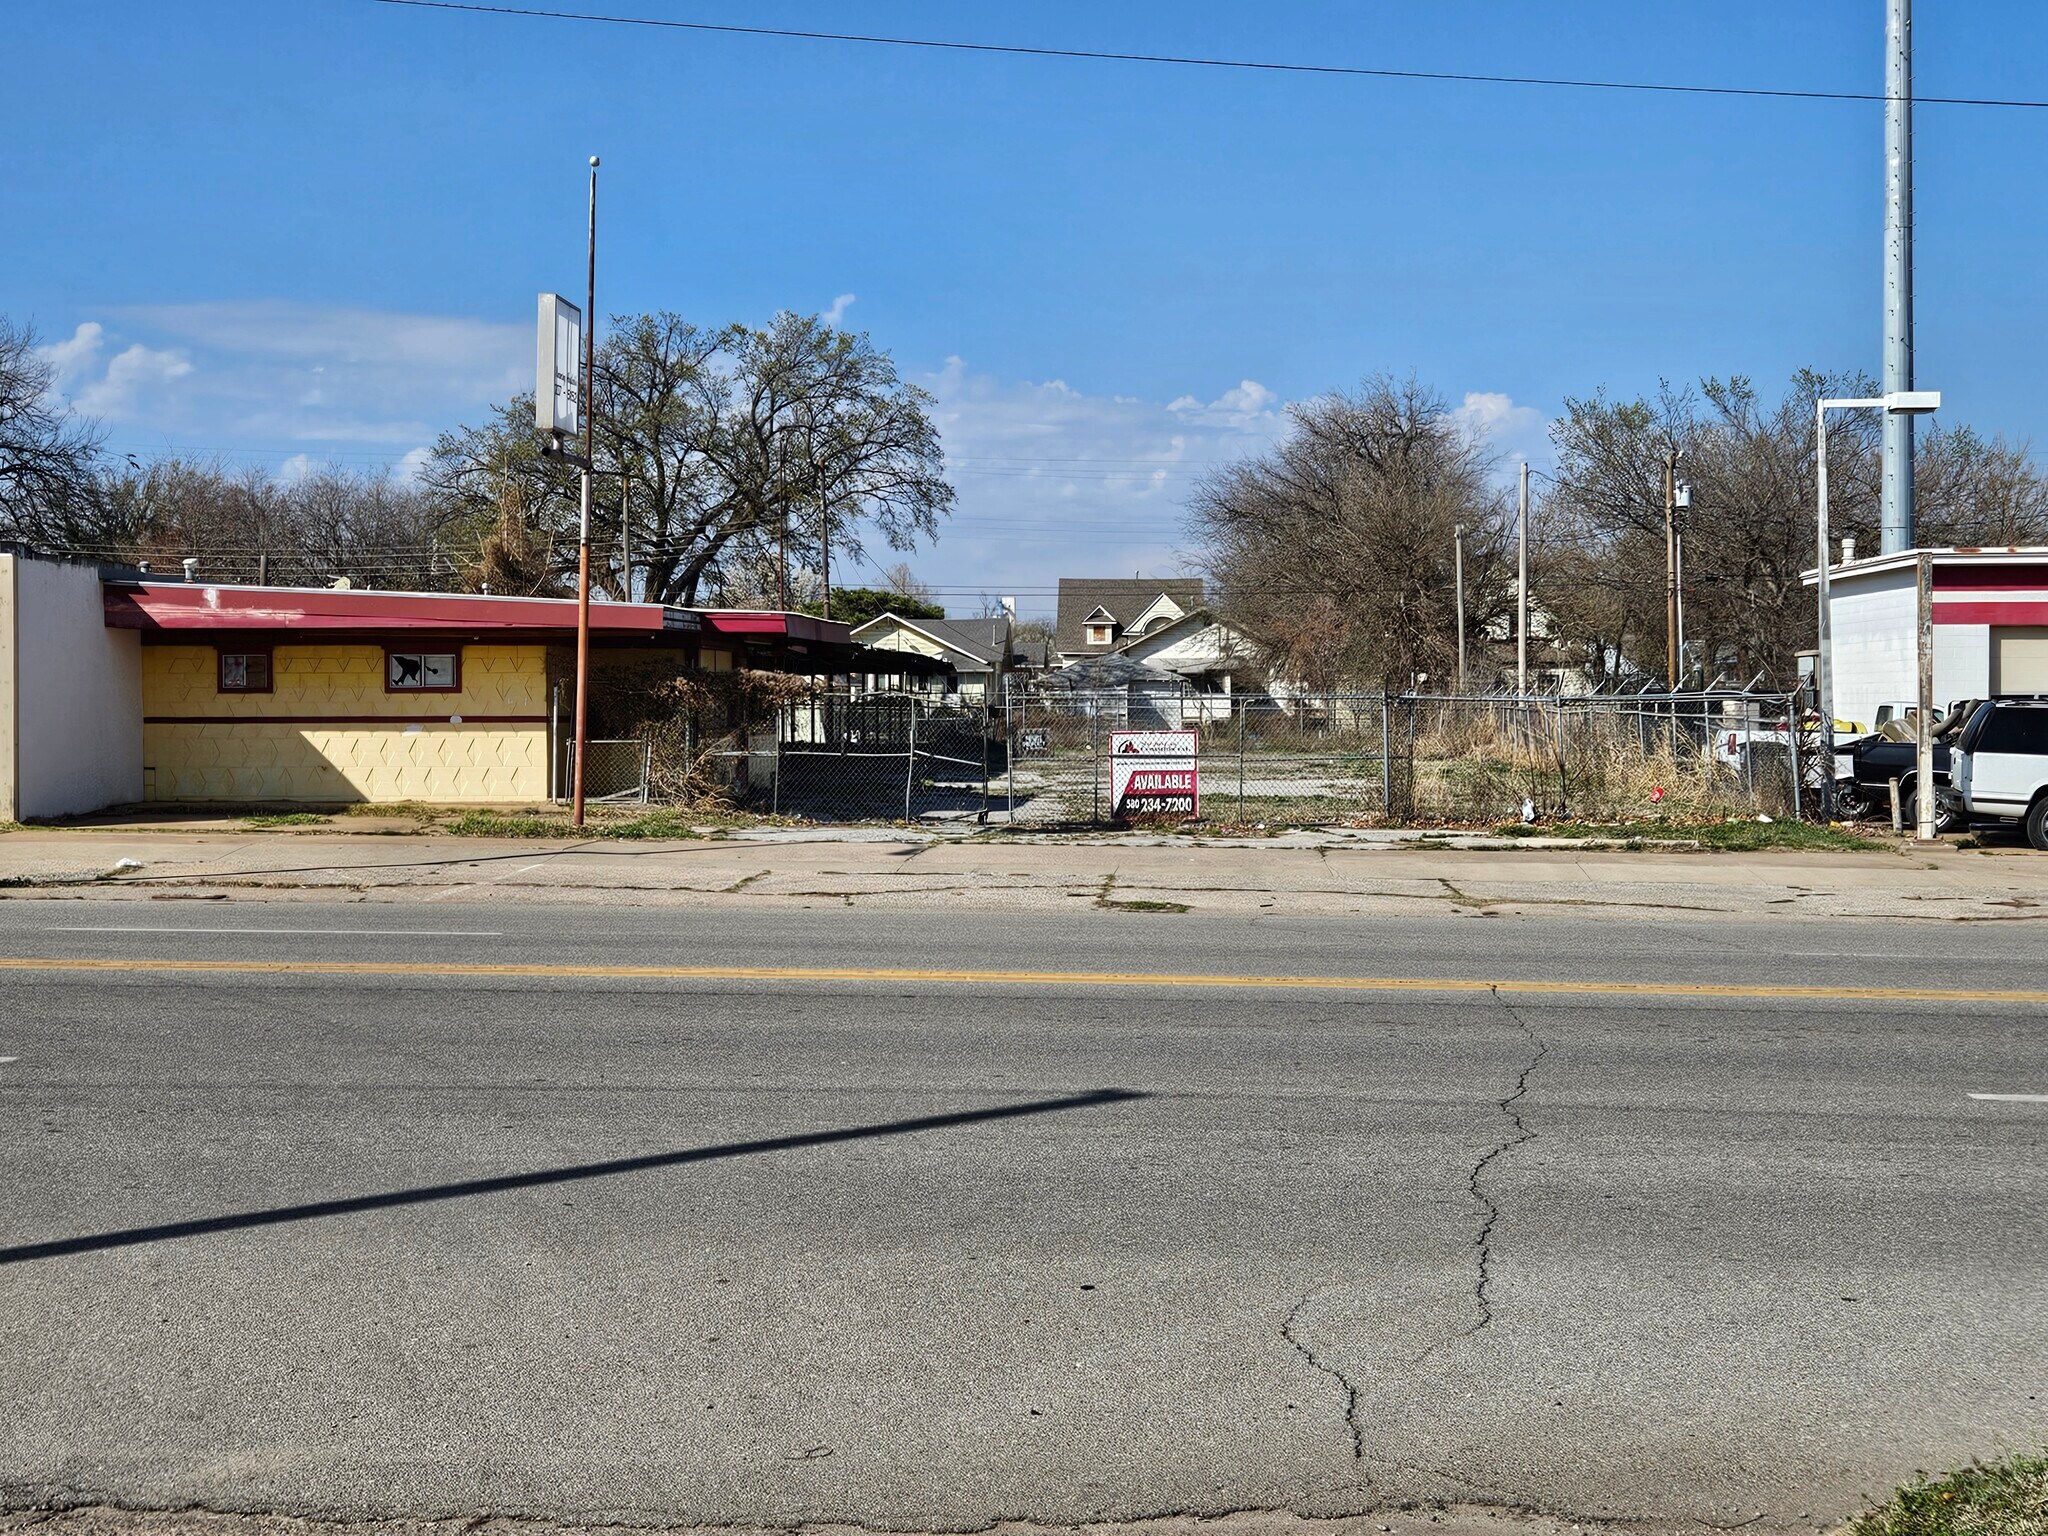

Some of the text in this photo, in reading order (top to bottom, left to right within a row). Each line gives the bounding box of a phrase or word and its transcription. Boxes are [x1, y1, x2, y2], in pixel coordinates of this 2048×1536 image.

[1134, 774, 1192, 789] AVAILABLE
[1126, 797, 1192, 812] 580 234-7200
